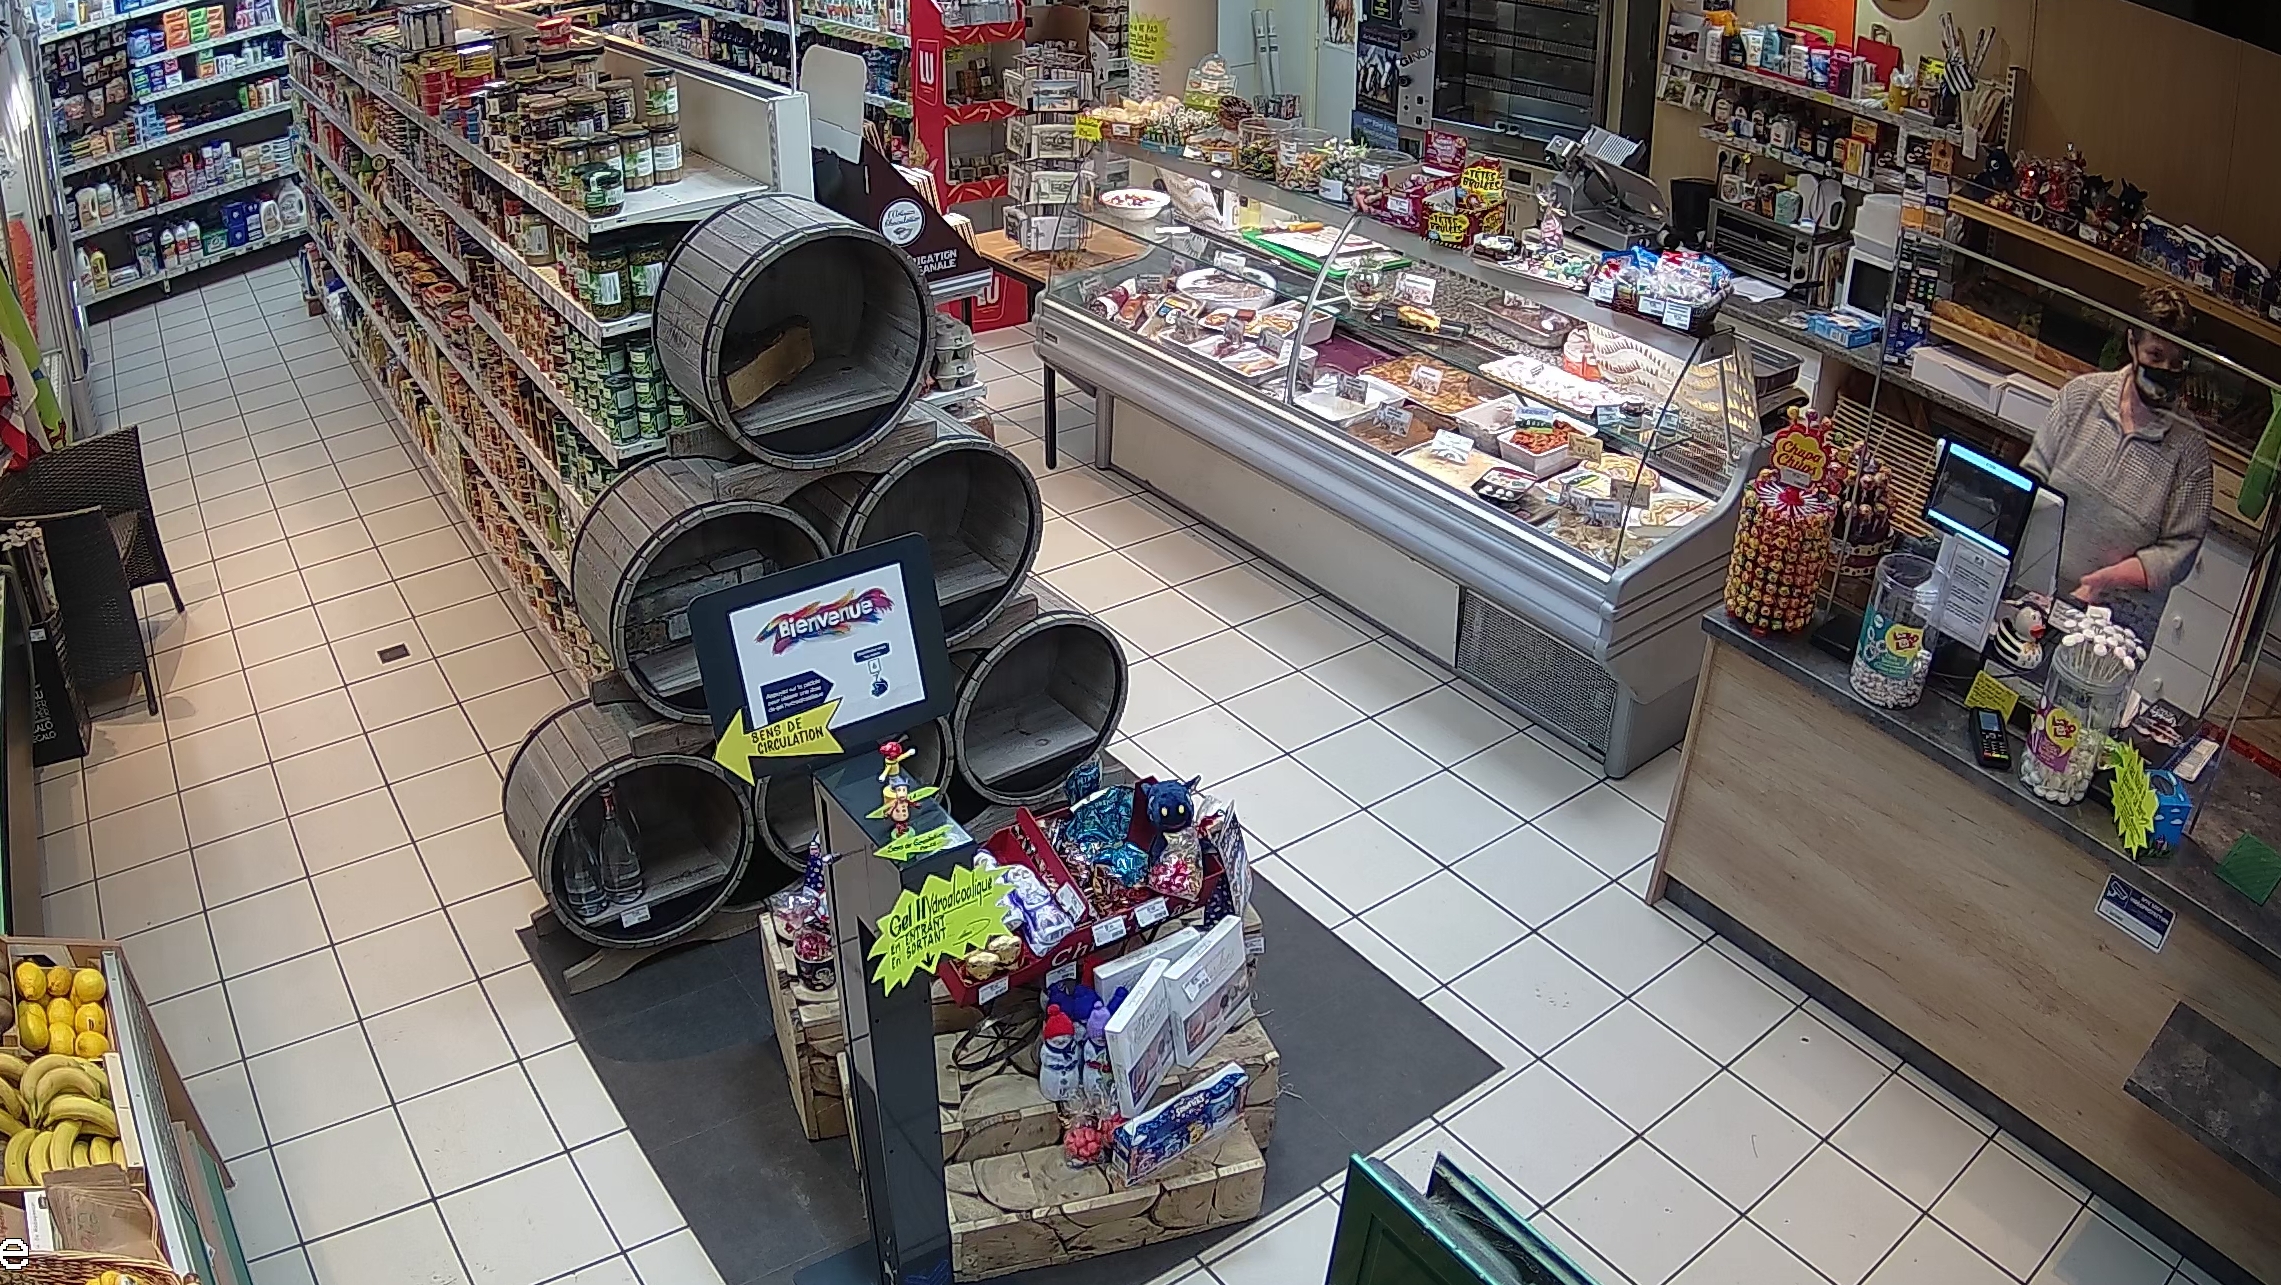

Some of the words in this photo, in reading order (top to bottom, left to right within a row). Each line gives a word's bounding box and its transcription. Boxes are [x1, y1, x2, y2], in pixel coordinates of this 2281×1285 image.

[919, 50, 934, 85] LU
[1782, 441, 1822, 462] Chupa
[779, 600, 874, 638] Bienvenue
[751, 724, 781, 744] SENS
[787, 717, 803, 732] DE
[757, 726, 824, 755] CIRCULATION
[889, 903, 912, 938] Gel
[905, 915, 945, 942] ENTRANT
[907, 928, 947, 959] SORTANT
